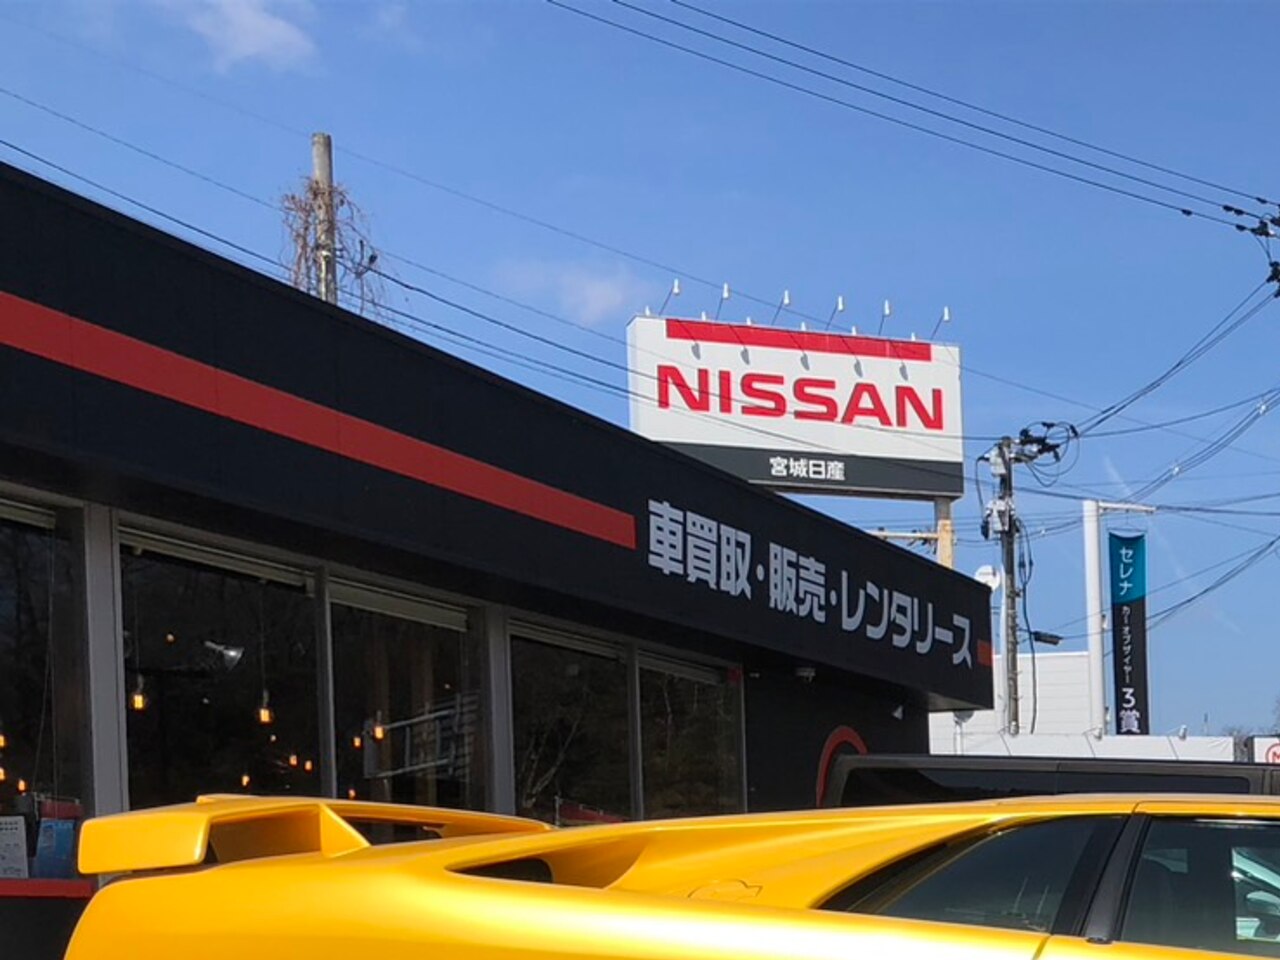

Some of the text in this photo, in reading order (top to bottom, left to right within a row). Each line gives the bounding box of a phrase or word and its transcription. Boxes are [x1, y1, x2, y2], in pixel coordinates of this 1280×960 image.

[657, 365, 943, 430] NISSAN
[769, 456, 845, 481] 宮城日産
[1119, 547, 1133, 595] セレナ
